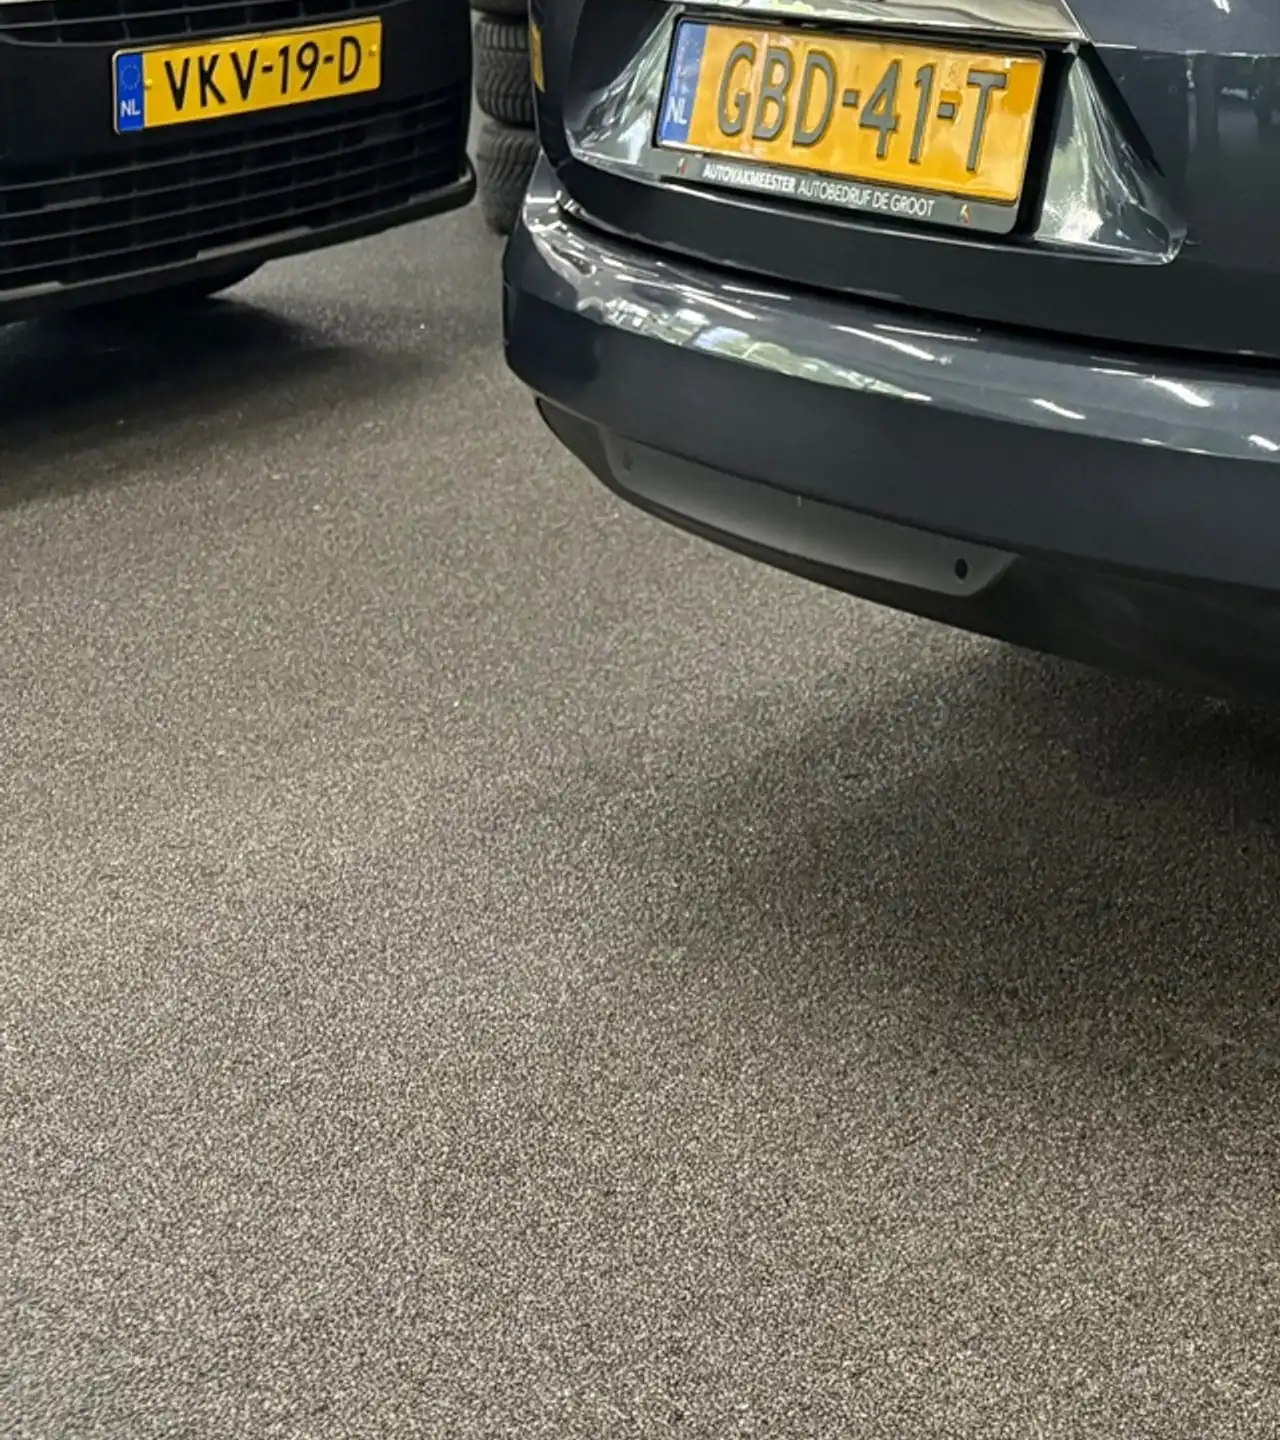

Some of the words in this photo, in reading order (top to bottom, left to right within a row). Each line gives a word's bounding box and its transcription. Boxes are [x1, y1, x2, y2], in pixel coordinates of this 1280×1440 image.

[164, 36, 362, 110] VKV-19-D
[120, 99, 142, 118] NL
[666, 95, 688, 125] NL
[717, 41, 1007, 173] GBD-41-T
[703, 162, 795, 193] AUTOVAKMEESTER
[798, 179, 872, 207] AUTOBEDRIJF
[872, 190, 890, 209] DE
[891, 195, 935, 217] GROOT
